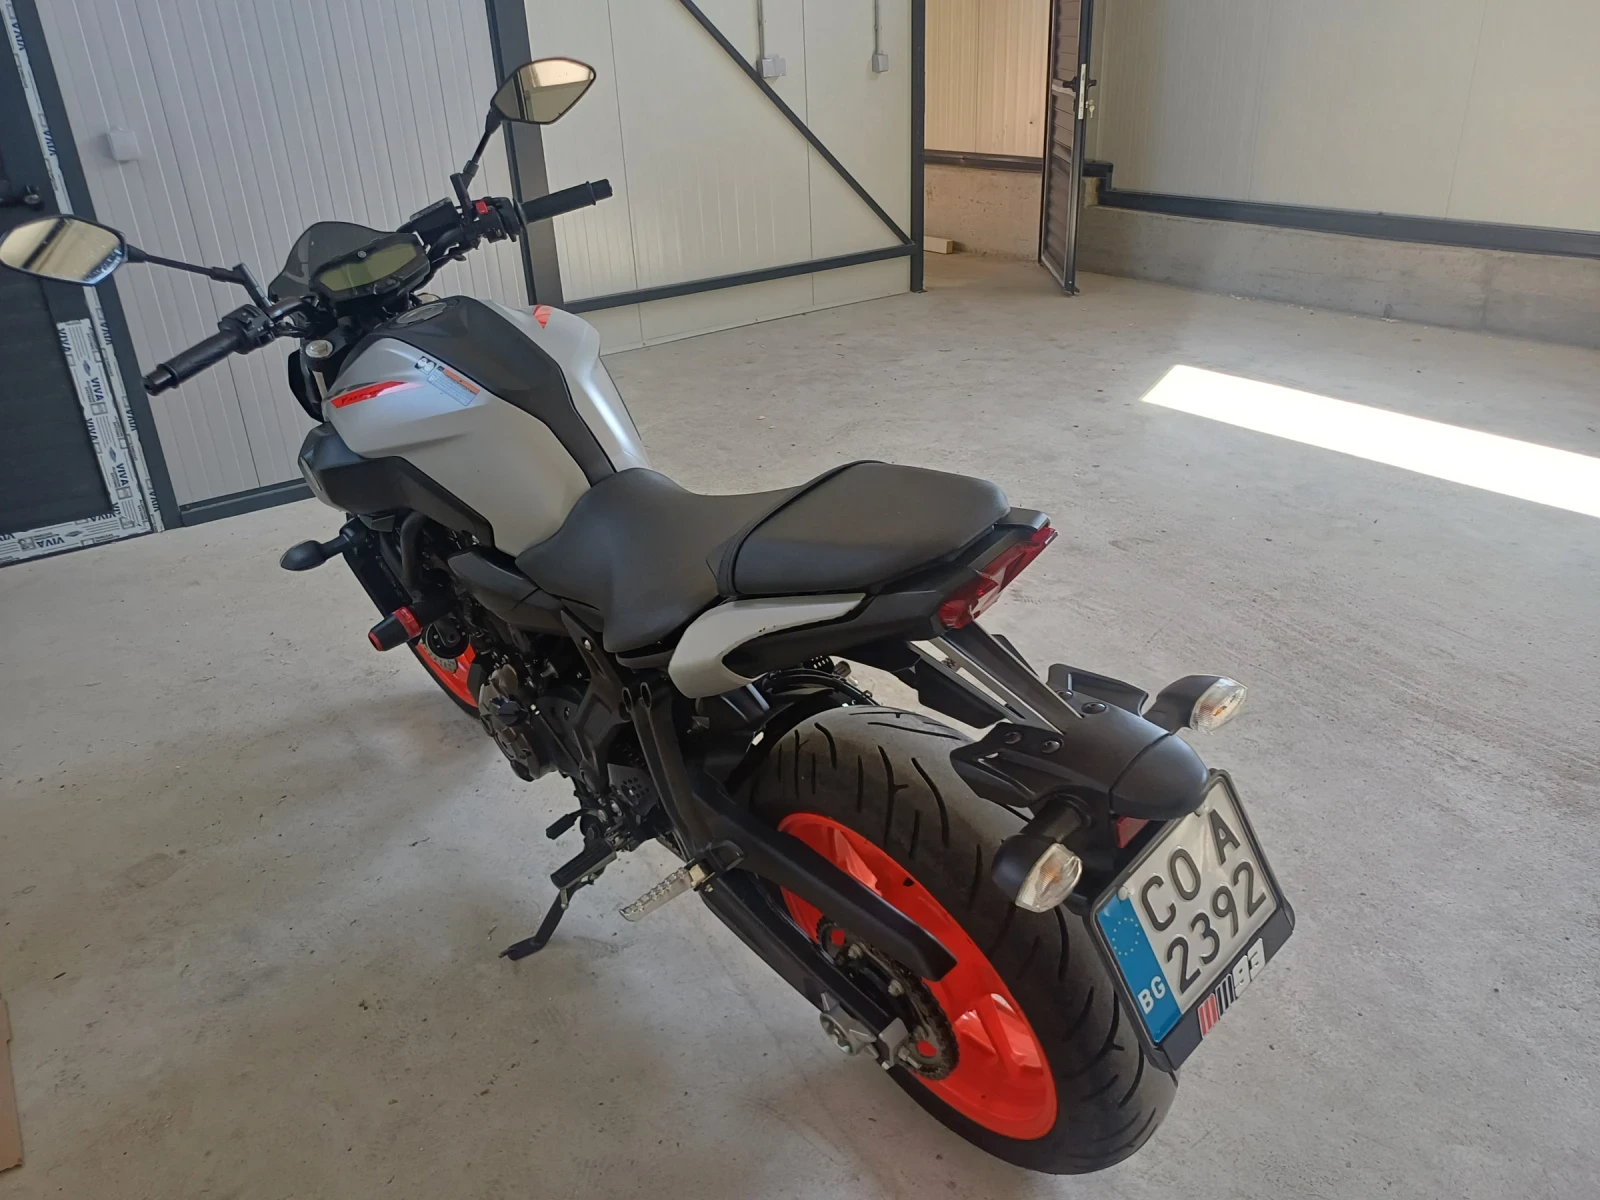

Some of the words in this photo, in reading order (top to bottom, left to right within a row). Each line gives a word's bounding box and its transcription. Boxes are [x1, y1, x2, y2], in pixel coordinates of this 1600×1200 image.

[90, 376, 104, 401] VIVA
[116, 462, 129, 486] VIVA
[36, 536, 66, 548] VIVA
[1140, 847, 1202, 932] CO
[1209, 808, 1241, 866] A
[1166, 860, 1267, 996] 2392
[1137, 976, 1167, 1015] BG
